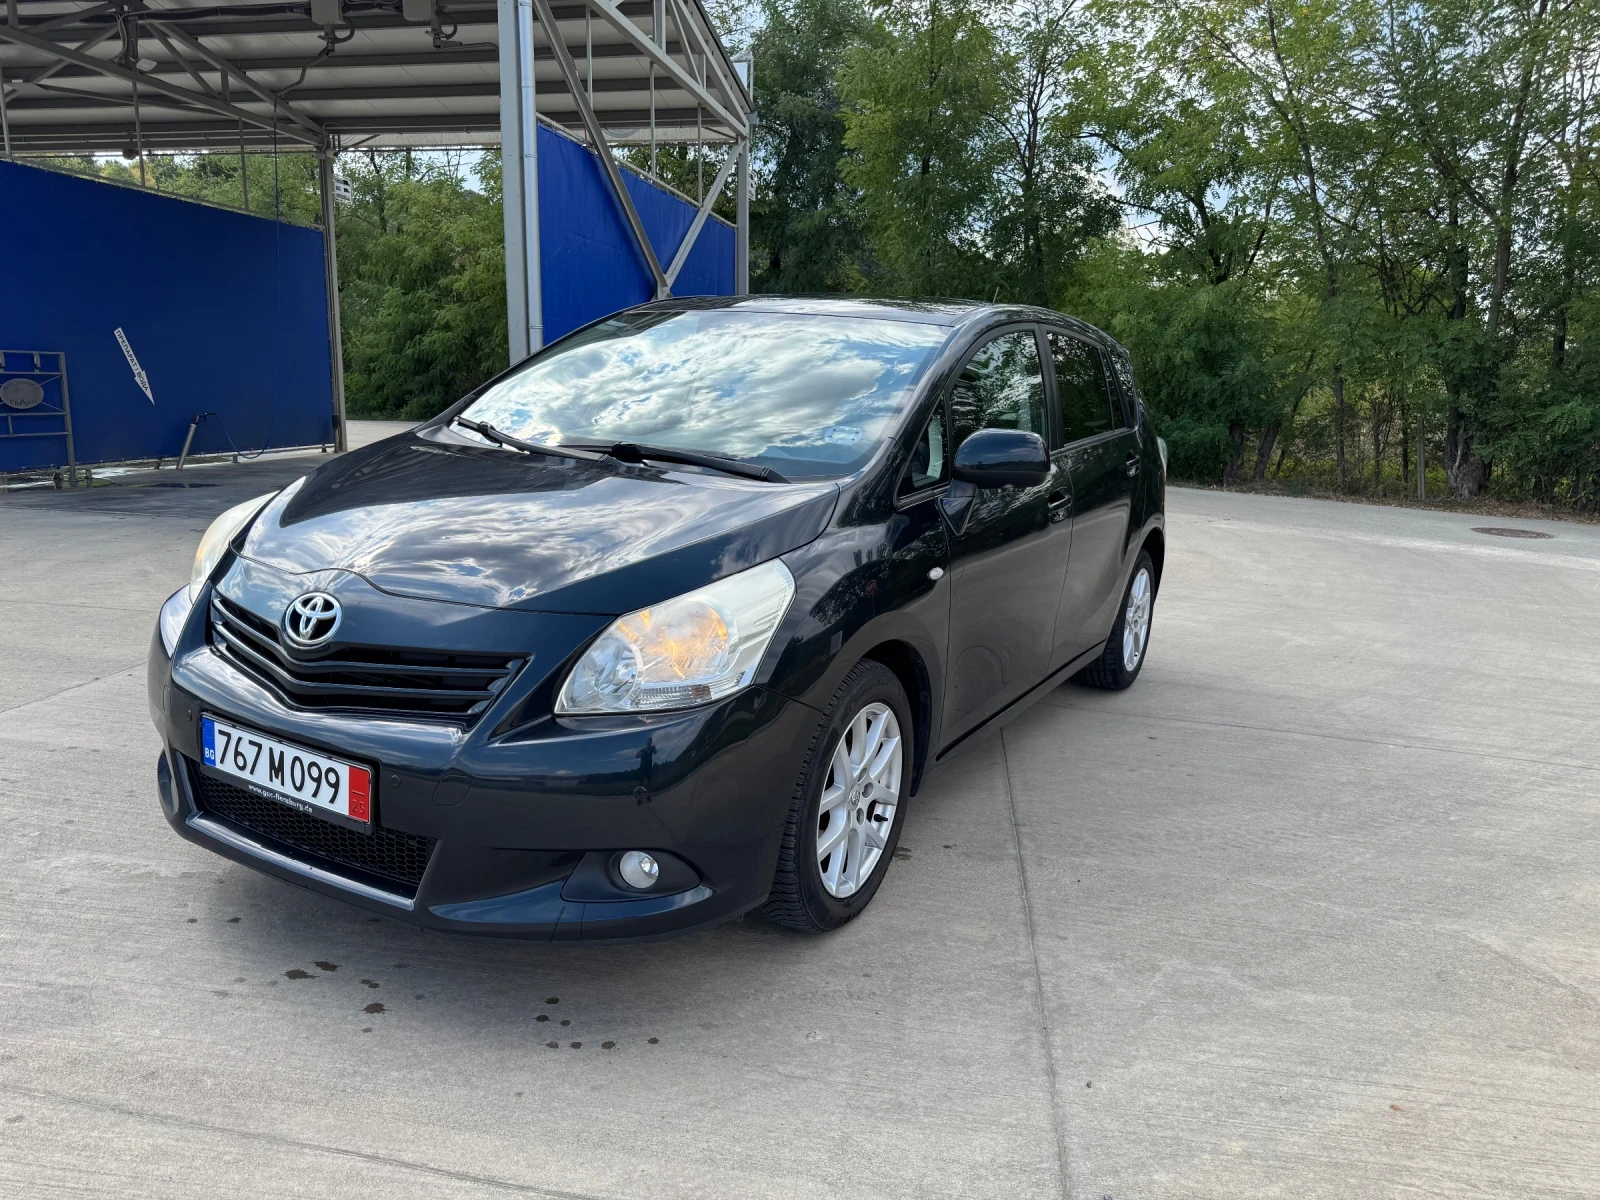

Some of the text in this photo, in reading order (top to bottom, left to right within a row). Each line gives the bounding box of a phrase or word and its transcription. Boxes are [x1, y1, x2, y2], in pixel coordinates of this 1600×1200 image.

[116, 330, 137, 367] ПРЕПАРАТ
[136, 371, 148, 392] ВОДА
[204, 747, 215, 760] BG
